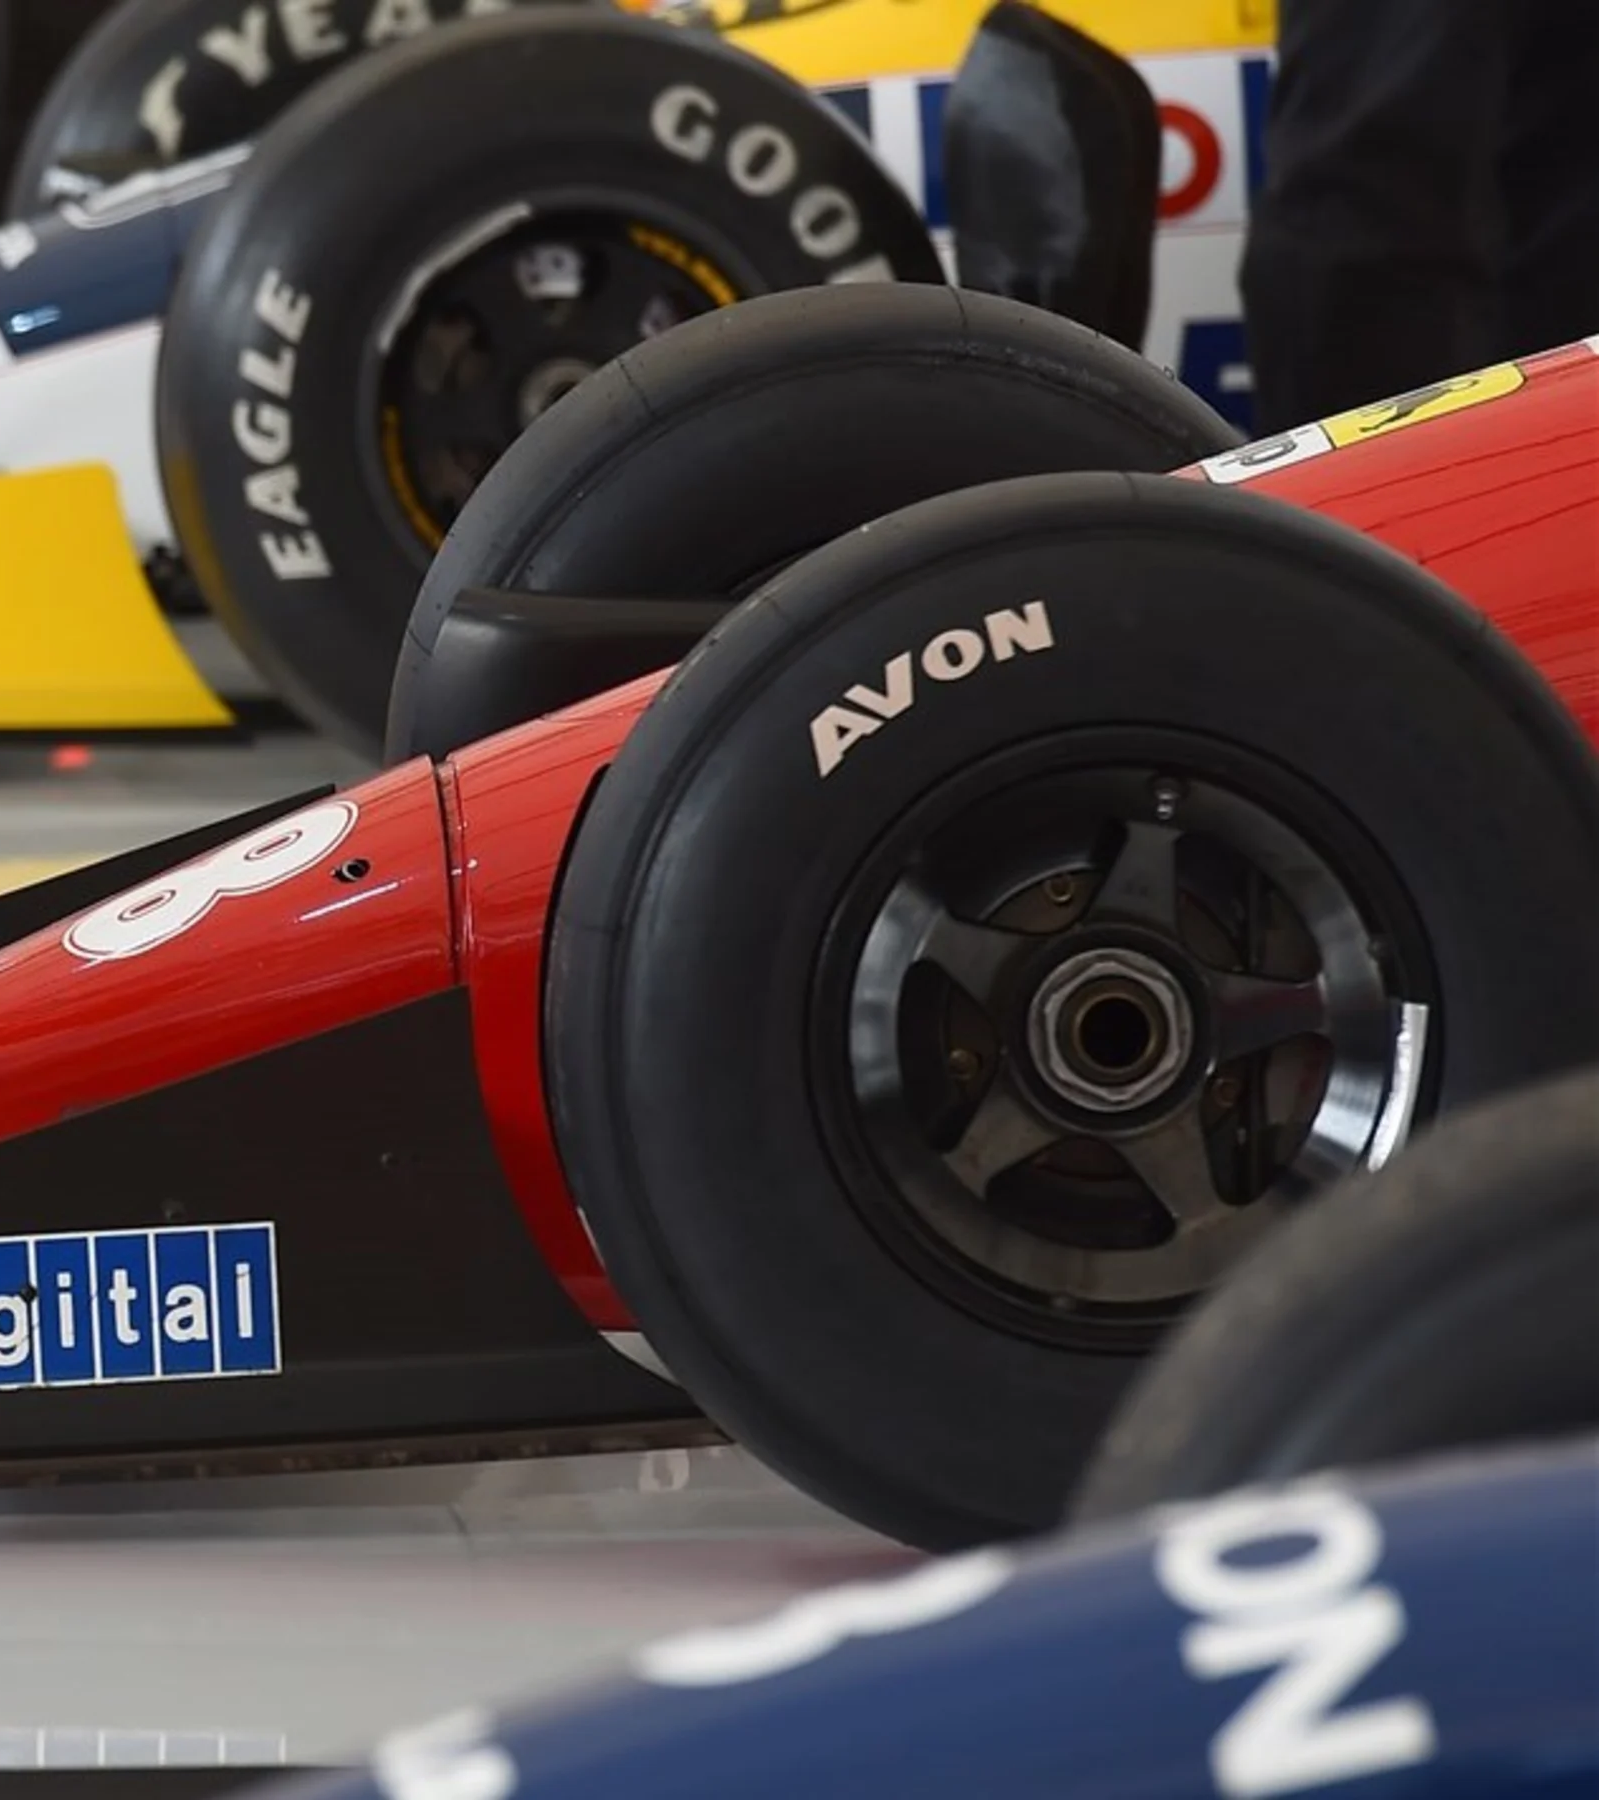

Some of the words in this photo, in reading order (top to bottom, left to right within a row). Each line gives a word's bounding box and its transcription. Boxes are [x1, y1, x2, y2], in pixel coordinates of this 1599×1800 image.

[231, 267, 333, 581] EAGLE
[809, 600, 1054, 778] AVON
[63, 800, 359, 960] 8
